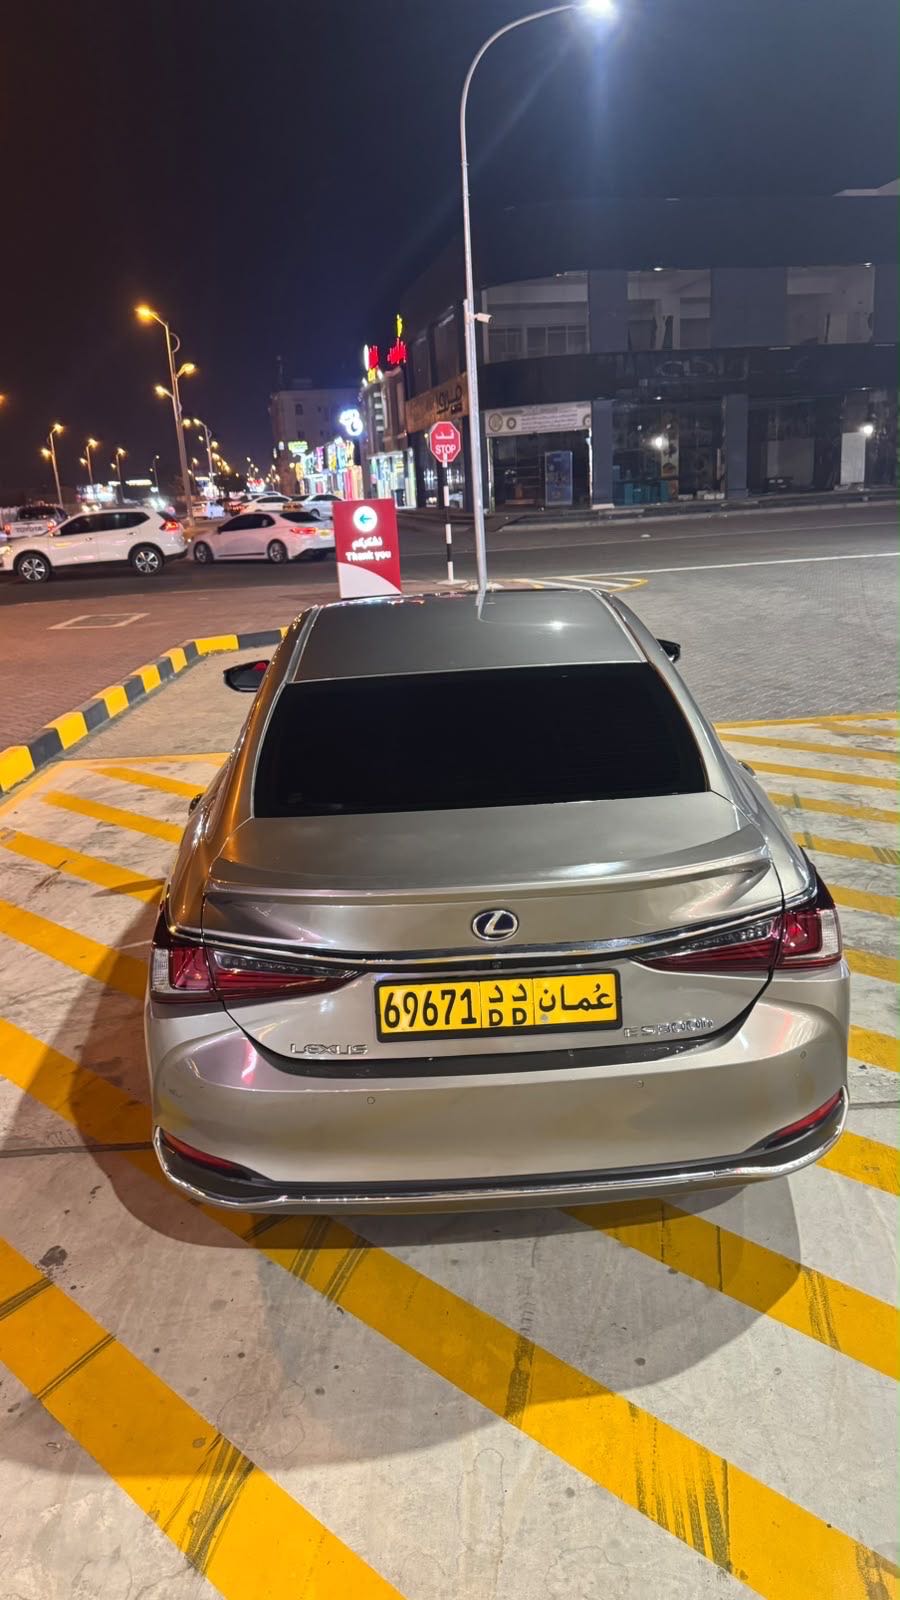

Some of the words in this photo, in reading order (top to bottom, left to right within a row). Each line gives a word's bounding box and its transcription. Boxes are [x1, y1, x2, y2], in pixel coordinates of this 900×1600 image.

[435, 444, 457, 455] STOP
[345, 551, 374, 561] Thank
[374, 551, 392, 561] you
[384, 988, 477, 1028] 69671
[291, 1043, 368, 1055] LEXUS
